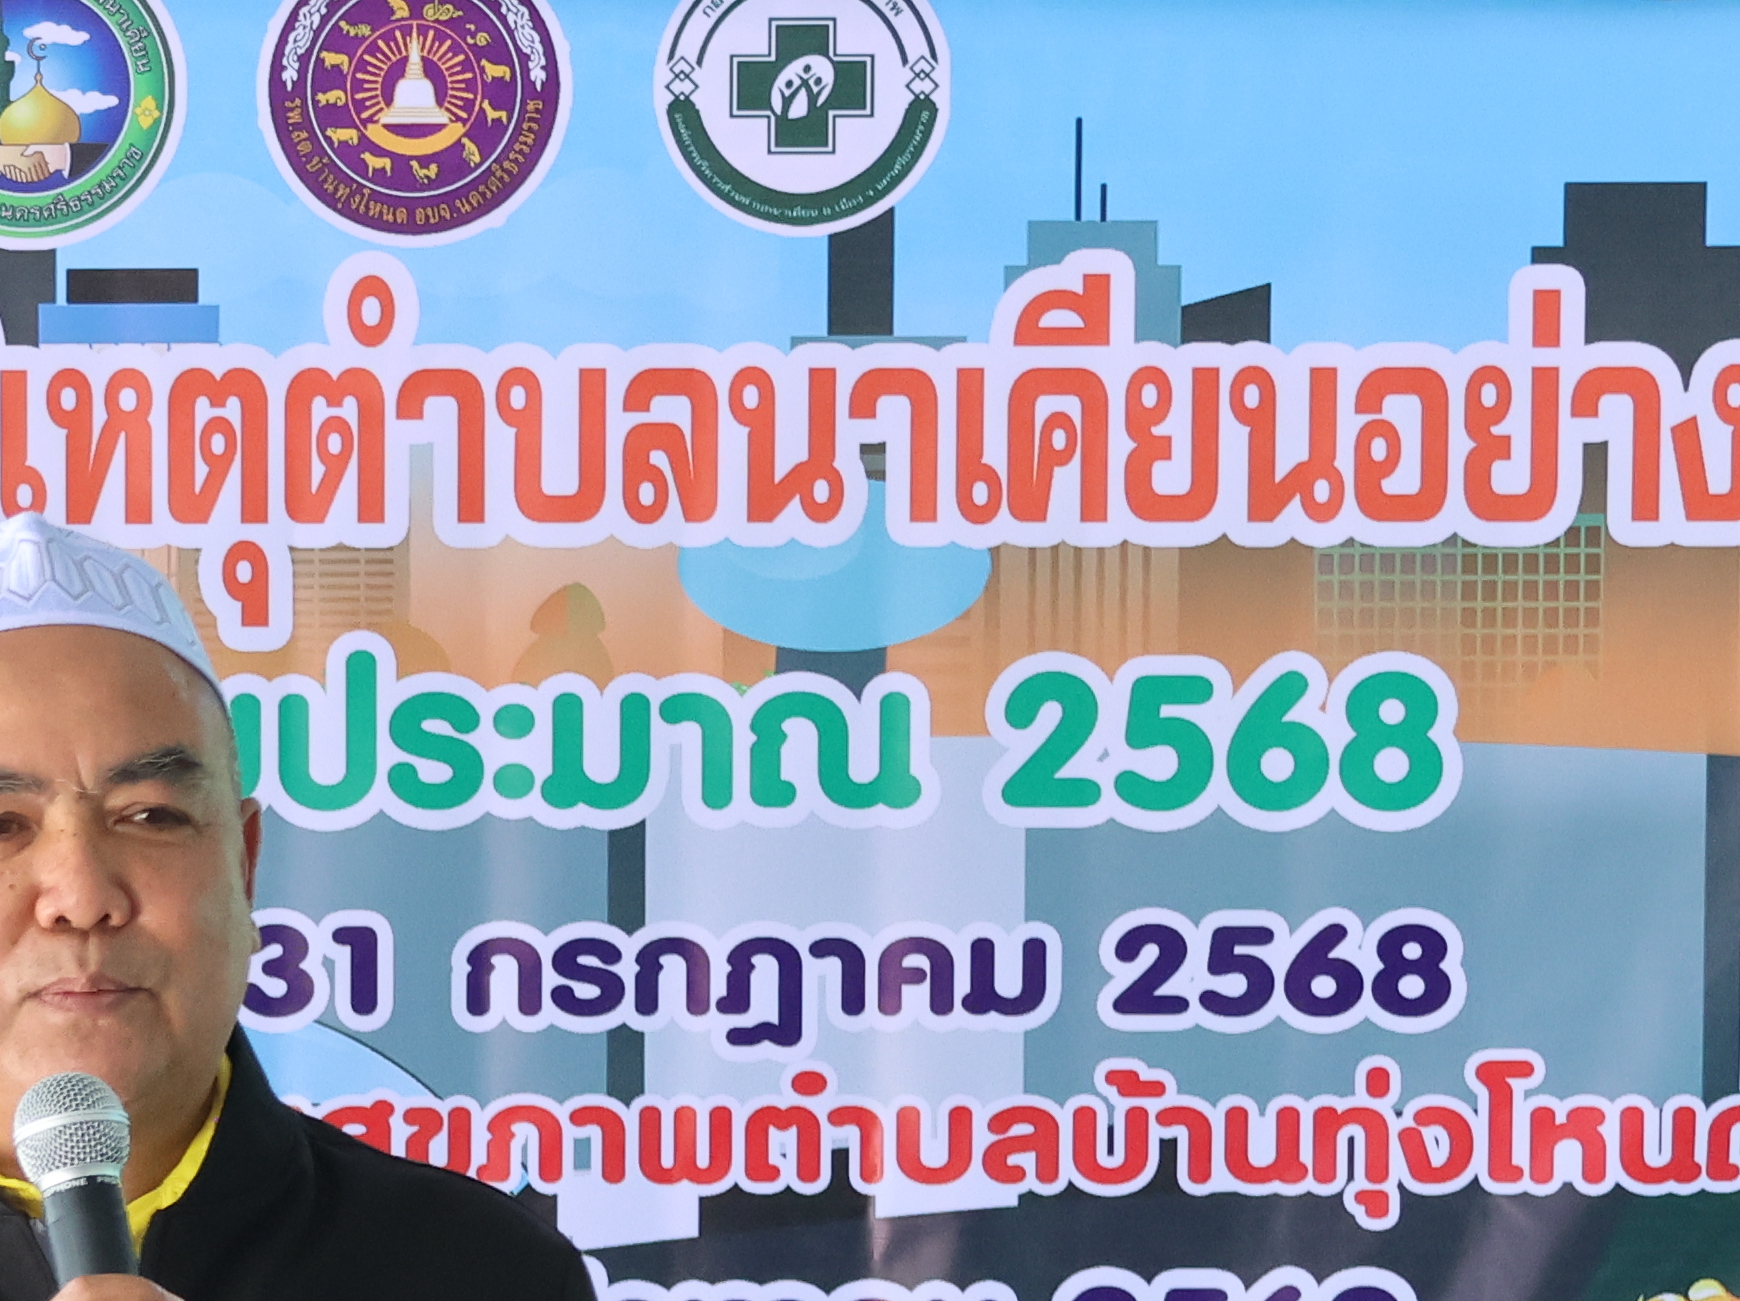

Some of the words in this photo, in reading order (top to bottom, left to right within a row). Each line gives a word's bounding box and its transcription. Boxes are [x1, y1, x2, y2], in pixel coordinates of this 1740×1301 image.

[1001, 668, 1447, 812] 2568
[244, 922, 380, 1019] 31
[465, 935, 1051, 1048] กรกฎาคม
[1117, 923, 1453, 1019] 2568
